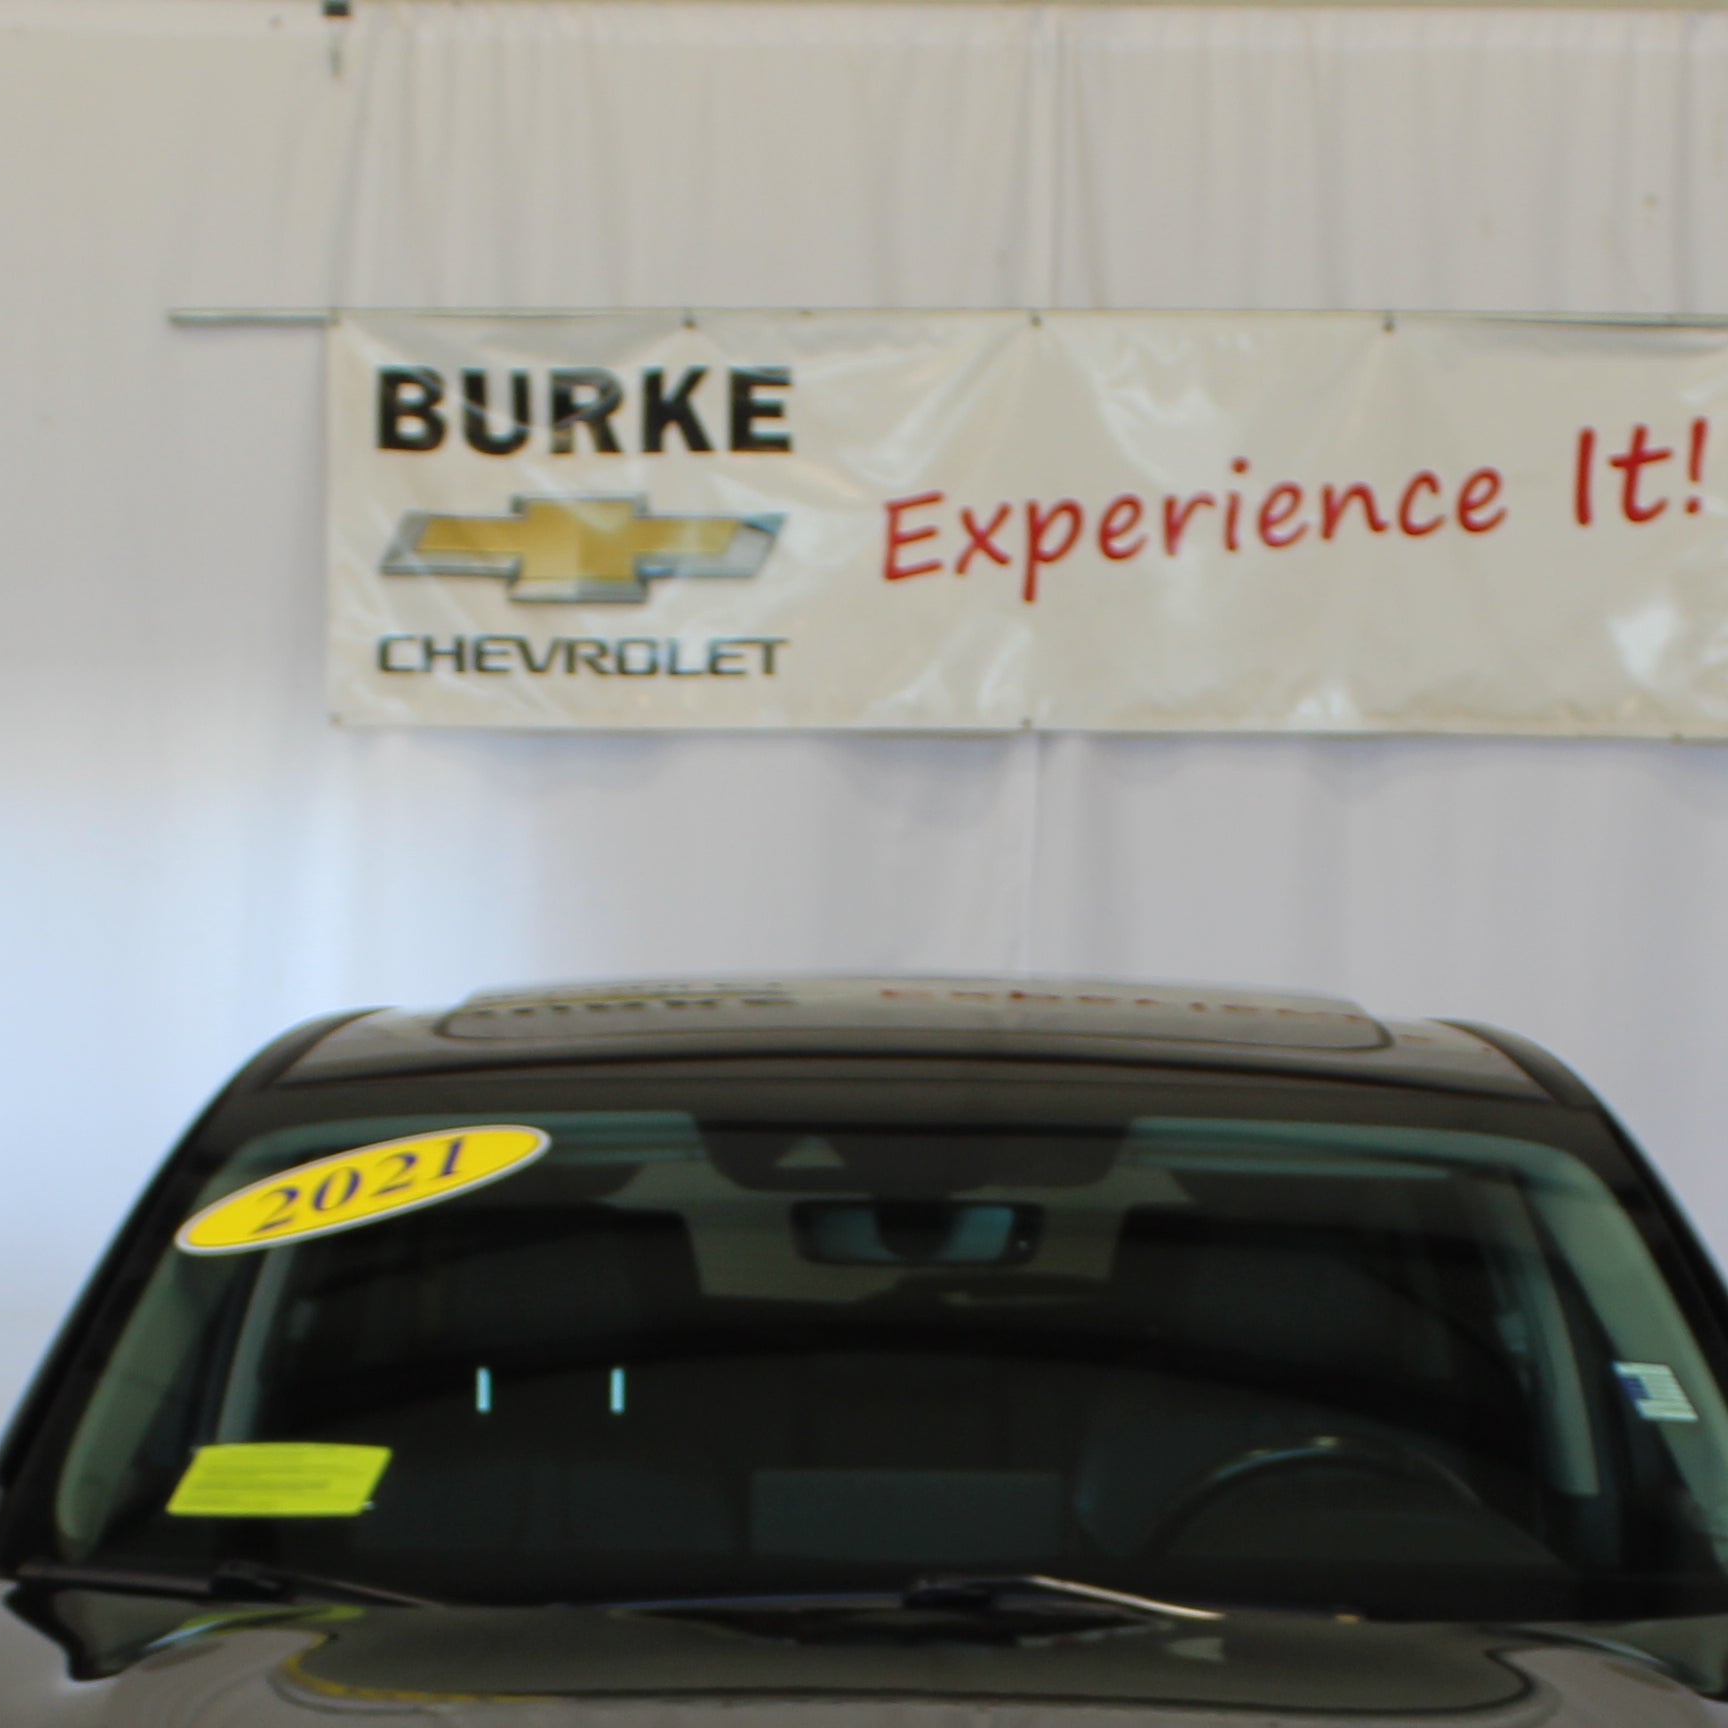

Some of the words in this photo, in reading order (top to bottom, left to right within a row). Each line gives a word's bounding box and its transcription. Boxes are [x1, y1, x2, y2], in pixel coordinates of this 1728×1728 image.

[376, 367, 793, 455] BURKE
[881, 457, 1508, 604] Experience
[1572, 417, 1711, 527] It!
[376, 633, 789, 678] CHEVROLET
[251, 1135, 469, 1236] 2021
